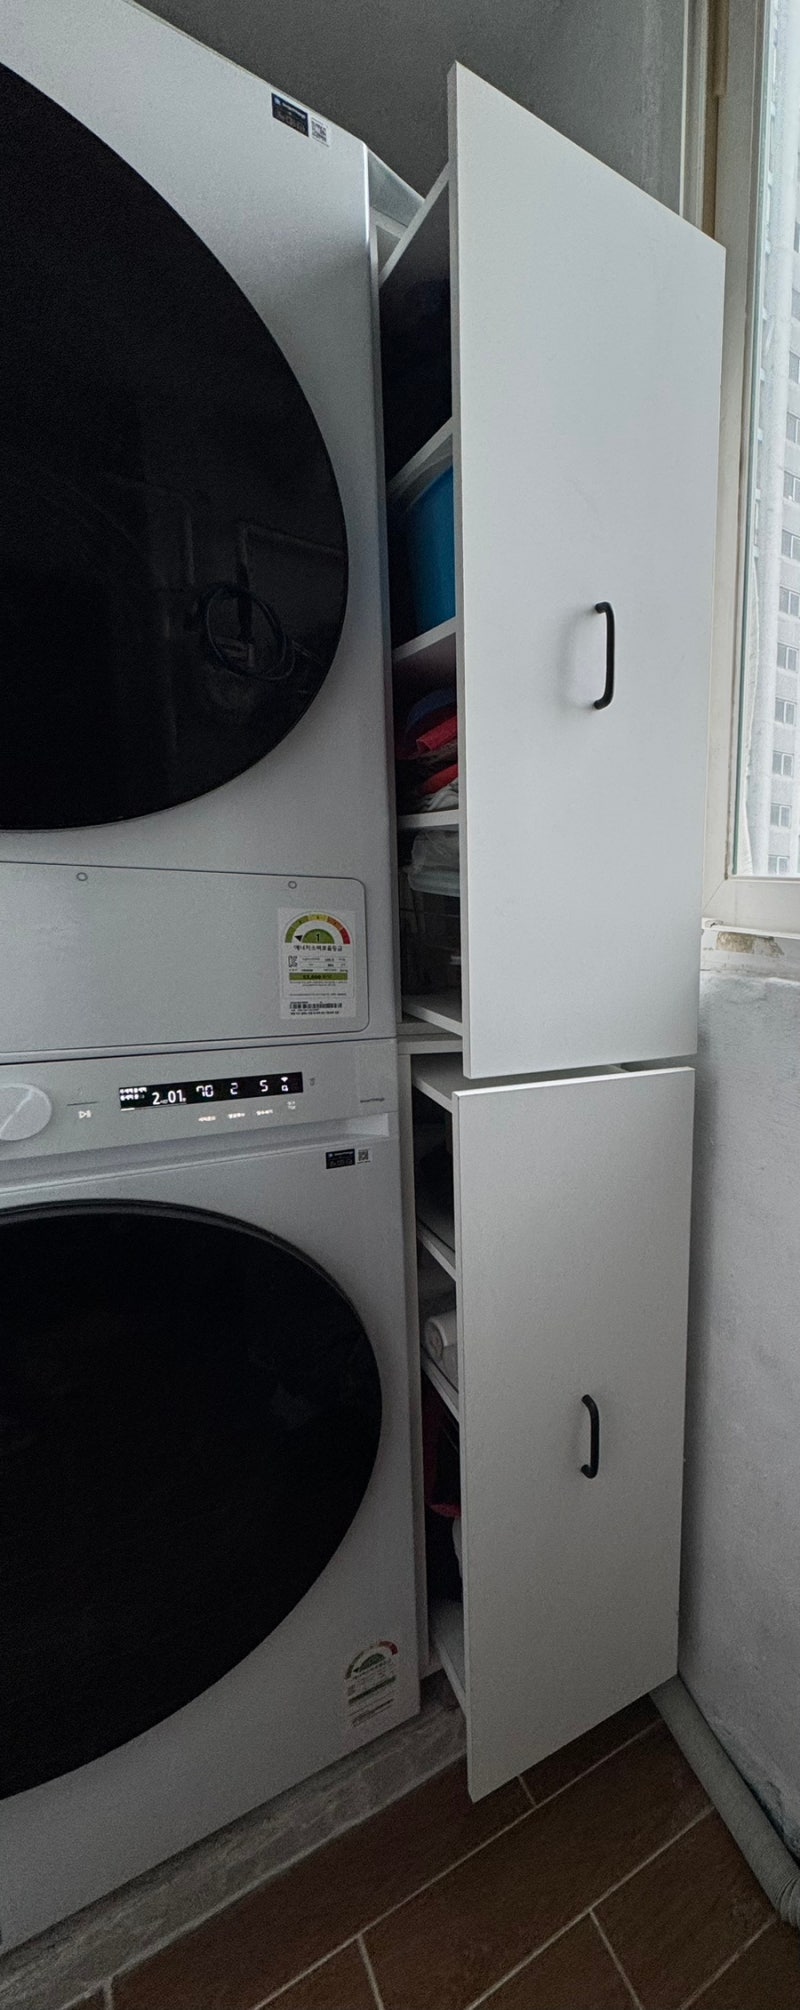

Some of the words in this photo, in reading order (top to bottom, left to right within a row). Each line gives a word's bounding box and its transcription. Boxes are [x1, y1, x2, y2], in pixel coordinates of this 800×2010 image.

[195, 1084, 214, 1098] 70
[229, 1082, 239, 1095] 2
[259, 1079, 269, 1092] 5
